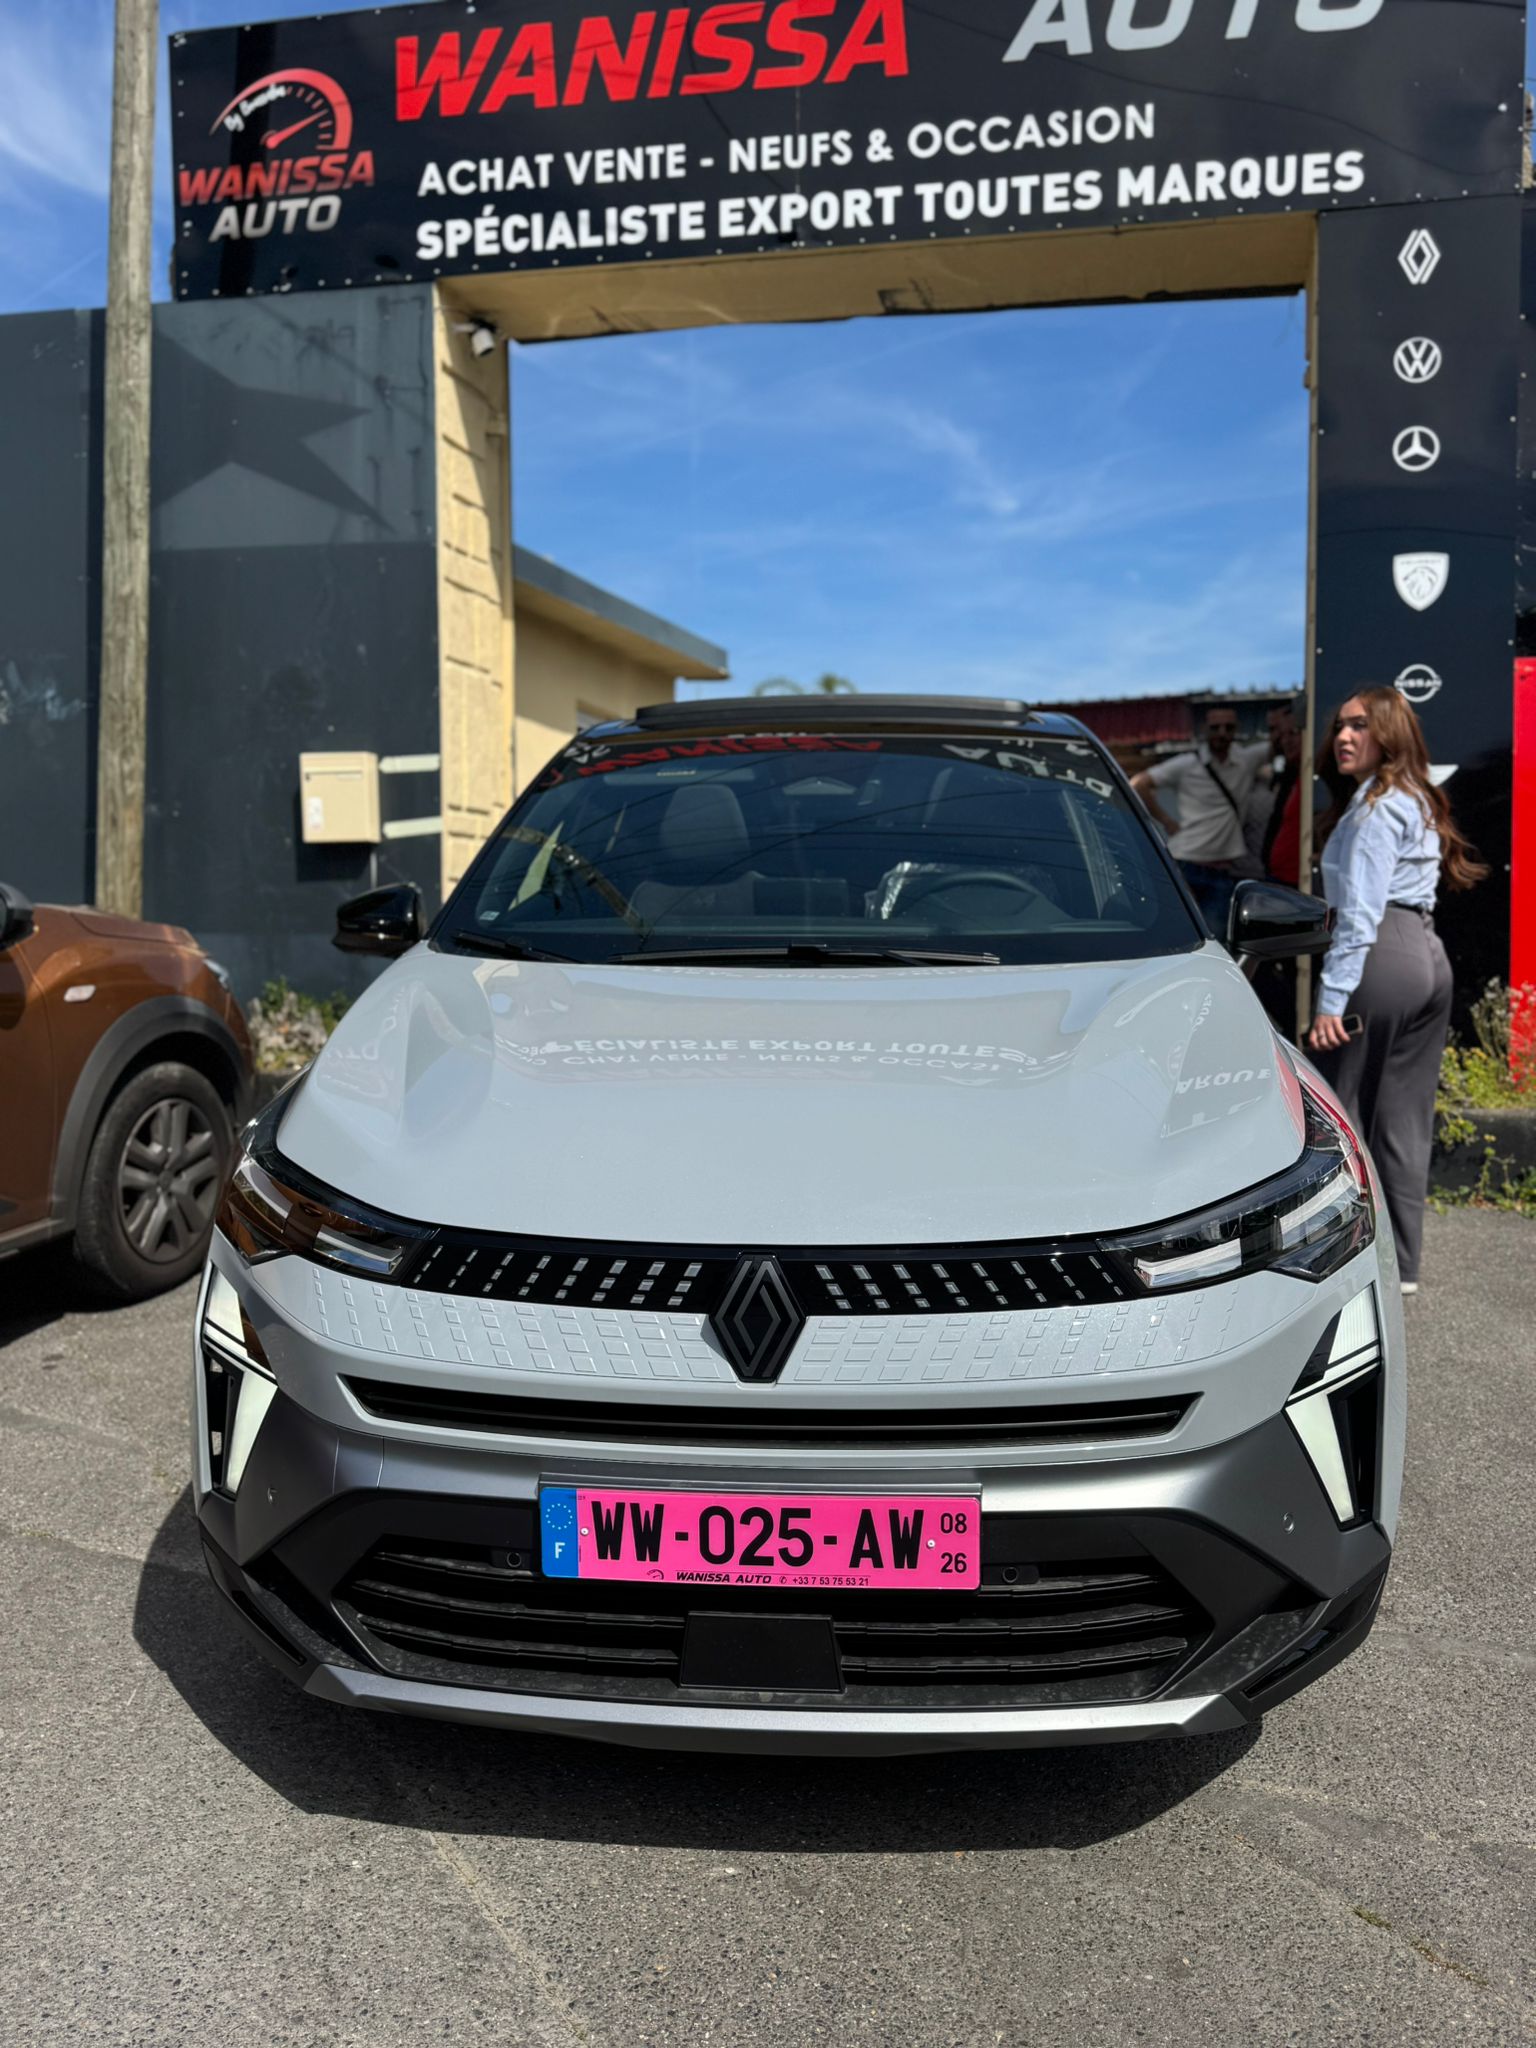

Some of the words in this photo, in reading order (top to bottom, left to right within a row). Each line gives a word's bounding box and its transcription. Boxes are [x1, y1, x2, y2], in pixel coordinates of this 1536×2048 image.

[395, 0, 909, 121] WANISSA
[417, 154, 555, 197] ACHAT
[562, 144, 687, 186] VENTE
[700, 158, 713, 167] -
[729, 130, 853, 174] NEUFS
[866, 129, 893, 163] &
[907, 103, 1155, 159] OCCASION
[179, 151, 375, 206] WANISSA
[416, 201, 706, 260] SPÉCIALISTE
[718, 186, 904, 238] EXPORT
[914, 170, 1103, 223] TOUTES
[1117, 150, 1365, 208] MARQUES
[209, 195, 342, 243] AUTO
[554, 1542, 566, 1559] F
[591, 1501, 924, 1570] WW-025-AW
[940, 1512, 967, 1534] 08
[676, 1571, 730, 1583] WANISSA
[735, 1574, 772, 1584] AUTO
[792, 1576, 809, 1586] +33
[811, 1576, 817, 1586] 7
[819, 1577, 830, 1586] 53
[832, 1577, 844, 1586] 75
[845, 1577, 857, 1587] 53
[858, 1577, 869, 1587] 21
[940, 1552, 967, 1574] 26
